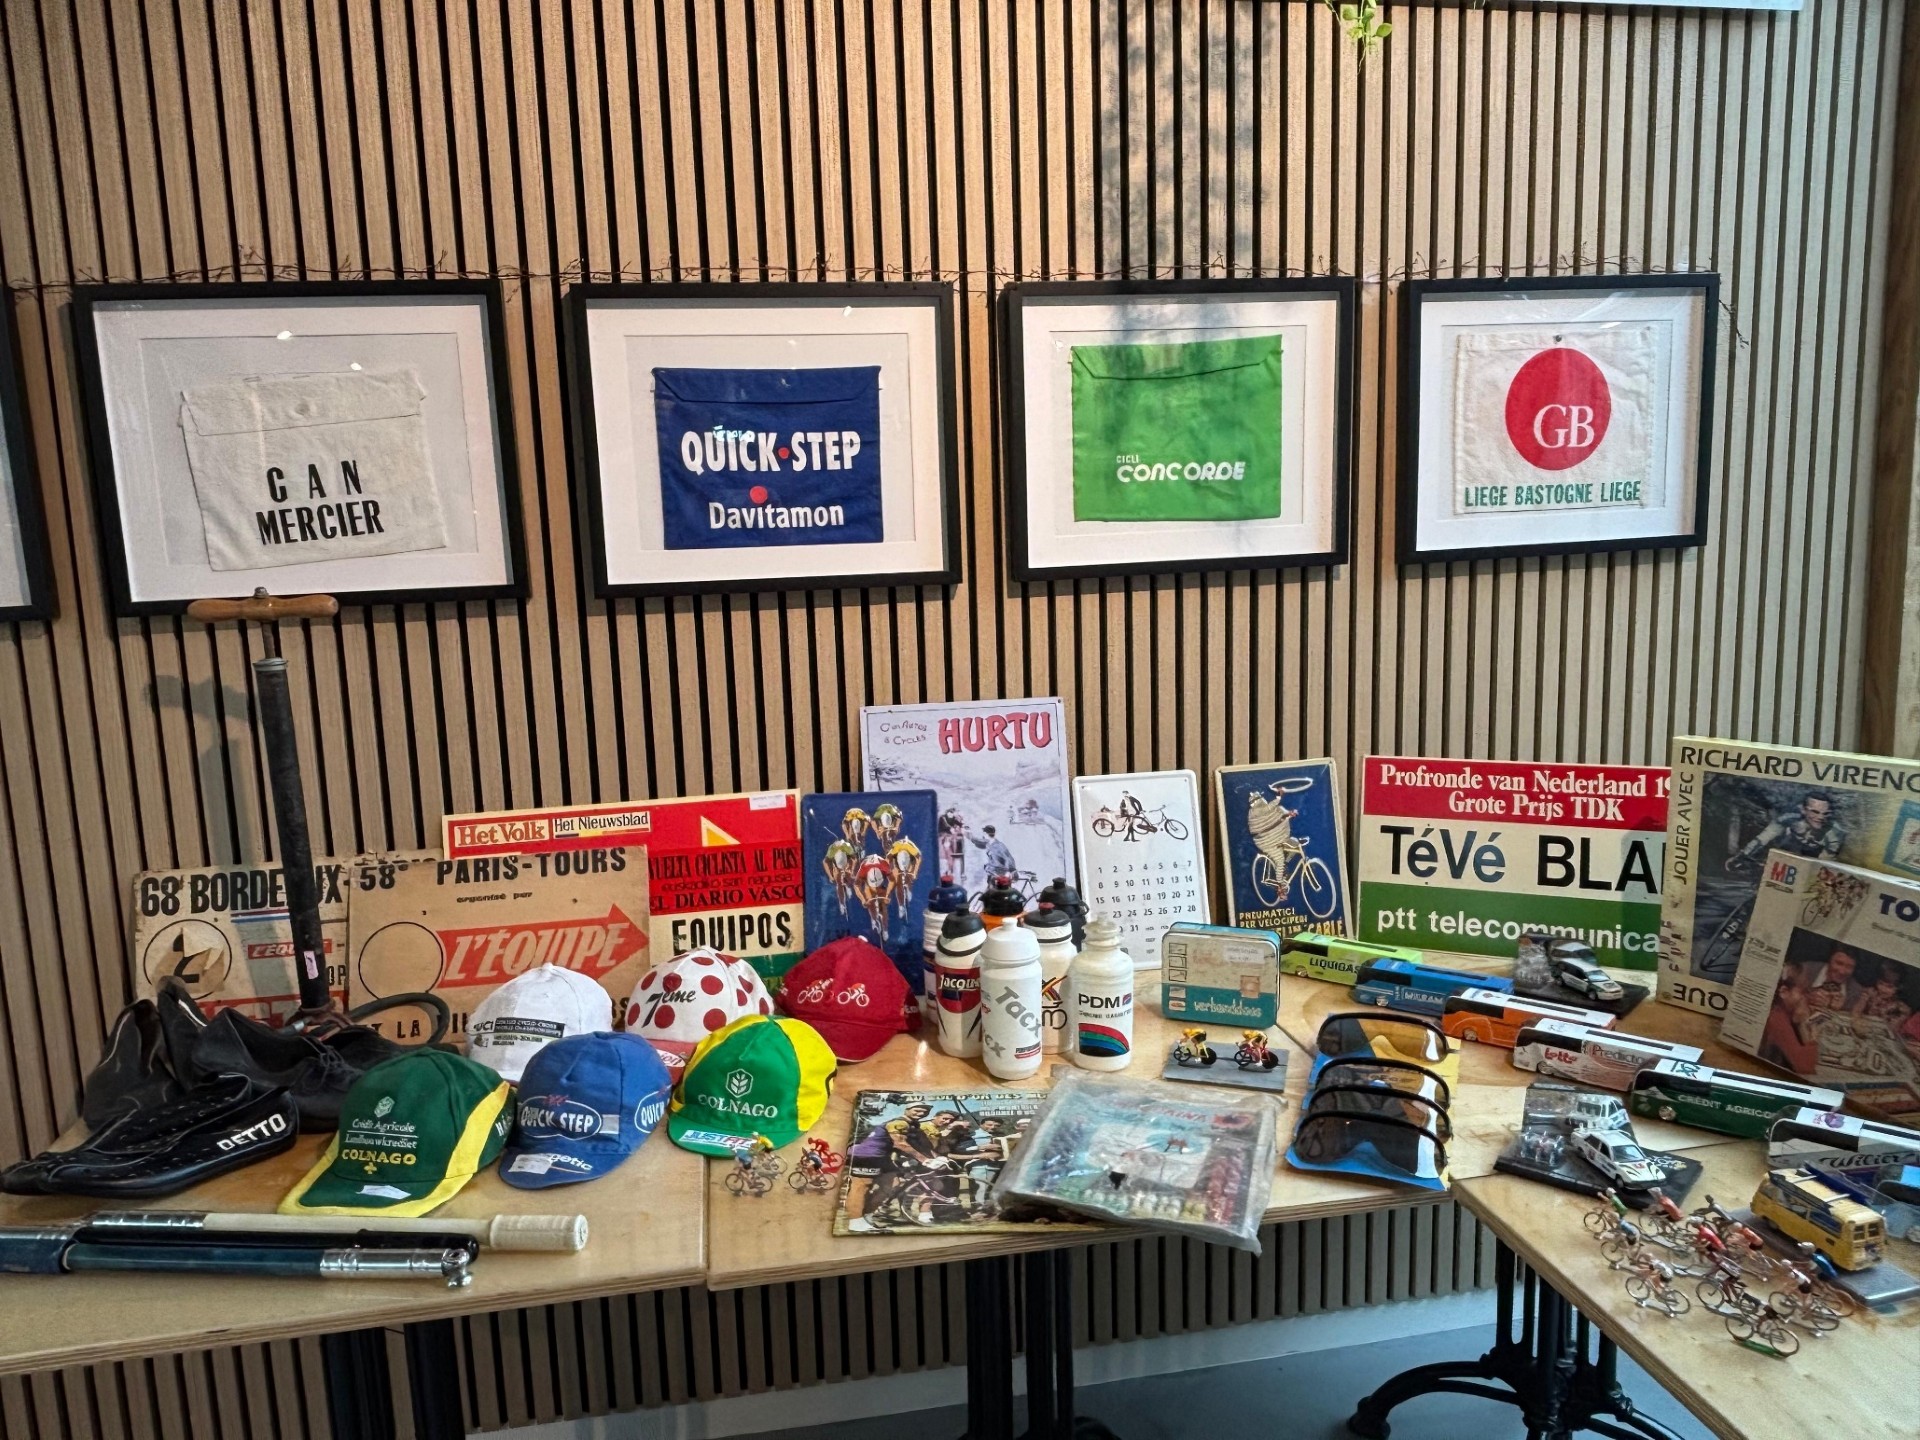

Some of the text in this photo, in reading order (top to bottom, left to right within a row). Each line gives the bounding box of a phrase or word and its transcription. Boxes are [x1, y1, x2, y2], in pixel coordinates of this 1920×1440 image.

[1533, 404, 1595, 448] GB
[681, 430, 861, 475] QUICK STEP
[1116, 455, 1139, 463] CICLI
[1116, 461, 1246, 482] CONCORDE
[1464, 480, 1641, 507] LIEGE BASTOGNE LIEGE
[255, 500, 385, 545] MERCIER
[708, 502, 844, 529] Davitamon
[938, 712, 1052, 754] HURTU
[1680, 746, 1803, 778] RICHARD
[1380, 764, 1484, 790] Profronde
[1489, 773, 1526, 792] van
[1532, 770, 1647, 797] Nederland
[1449, 791, 1625, 821] Grote Prijs TDK
[458, 822, 547, 847] Het Volk
[553, 811, 649, 832] Het Nieuwsblad
[1673, 771, 1694, 885] JOUER AVEC
[436, 846, 627, 885] PARIS-TOURS
[1113, 865, 1118, 873] 2
[1128, 864, 1133, 872] 3
[1143, 863, 1148, 871] 4
[1158, 862, 1163, 870] 5
[1173, 861, 1178, 869] 6
[1380, 825, 1666, 895] TéVé BLA
[1771, 861, 1797, 885] MB
[141, 864, 343, 917] 68 BORDEX
[1098, 881, 1104, 889] 8
[1125, 879, 1135, 887] 10
[1142, 878, 1150, 886] 11
[1156, 877, 1165, 885] 12
[1171, 876, 1179, 884] 13
[1185, 875, 1193, 883] 14
[674, 889, 744, 909] DIARIO
[748, 884, 804, 901] VASCO
[1127, 894, 1136, 902] 17
[1142, 893, 1151, 901] 18
[1157, 892, 1167, 900] 19
[1171, 891, 1181, 899] 20
[1186, 890, 1195, 898] 21
[1113, 910, 1122, 919] 23
[1127, 909, 1137, 918] 24
[1143, 908, 1153, 916] 25
[1158, 907, 1168, 915] 26
[1173, 906, 1182, 914] 27
[1239, 906, 1295, 921] PNEUMATICI
[1377, 907, 1418, 933] ptt
[672, 911, 792, 956] EQUIPOS
[1130, 924, 1139, 932] 31
[995, 986, 1041, 1038] Tacx
[1078, 993, 1120, 1008] PDM
[397, 1020, 420, 1038] LA
[520, 1106, 558, 1129] QUICK
[560, 1111, 594, 1133] STEP
[698, 1094, 779, 1119] COLNAGO
[217, 1113, 287, 1150] DETTO
[341, 1149, 417, 1165] COLNAGO
